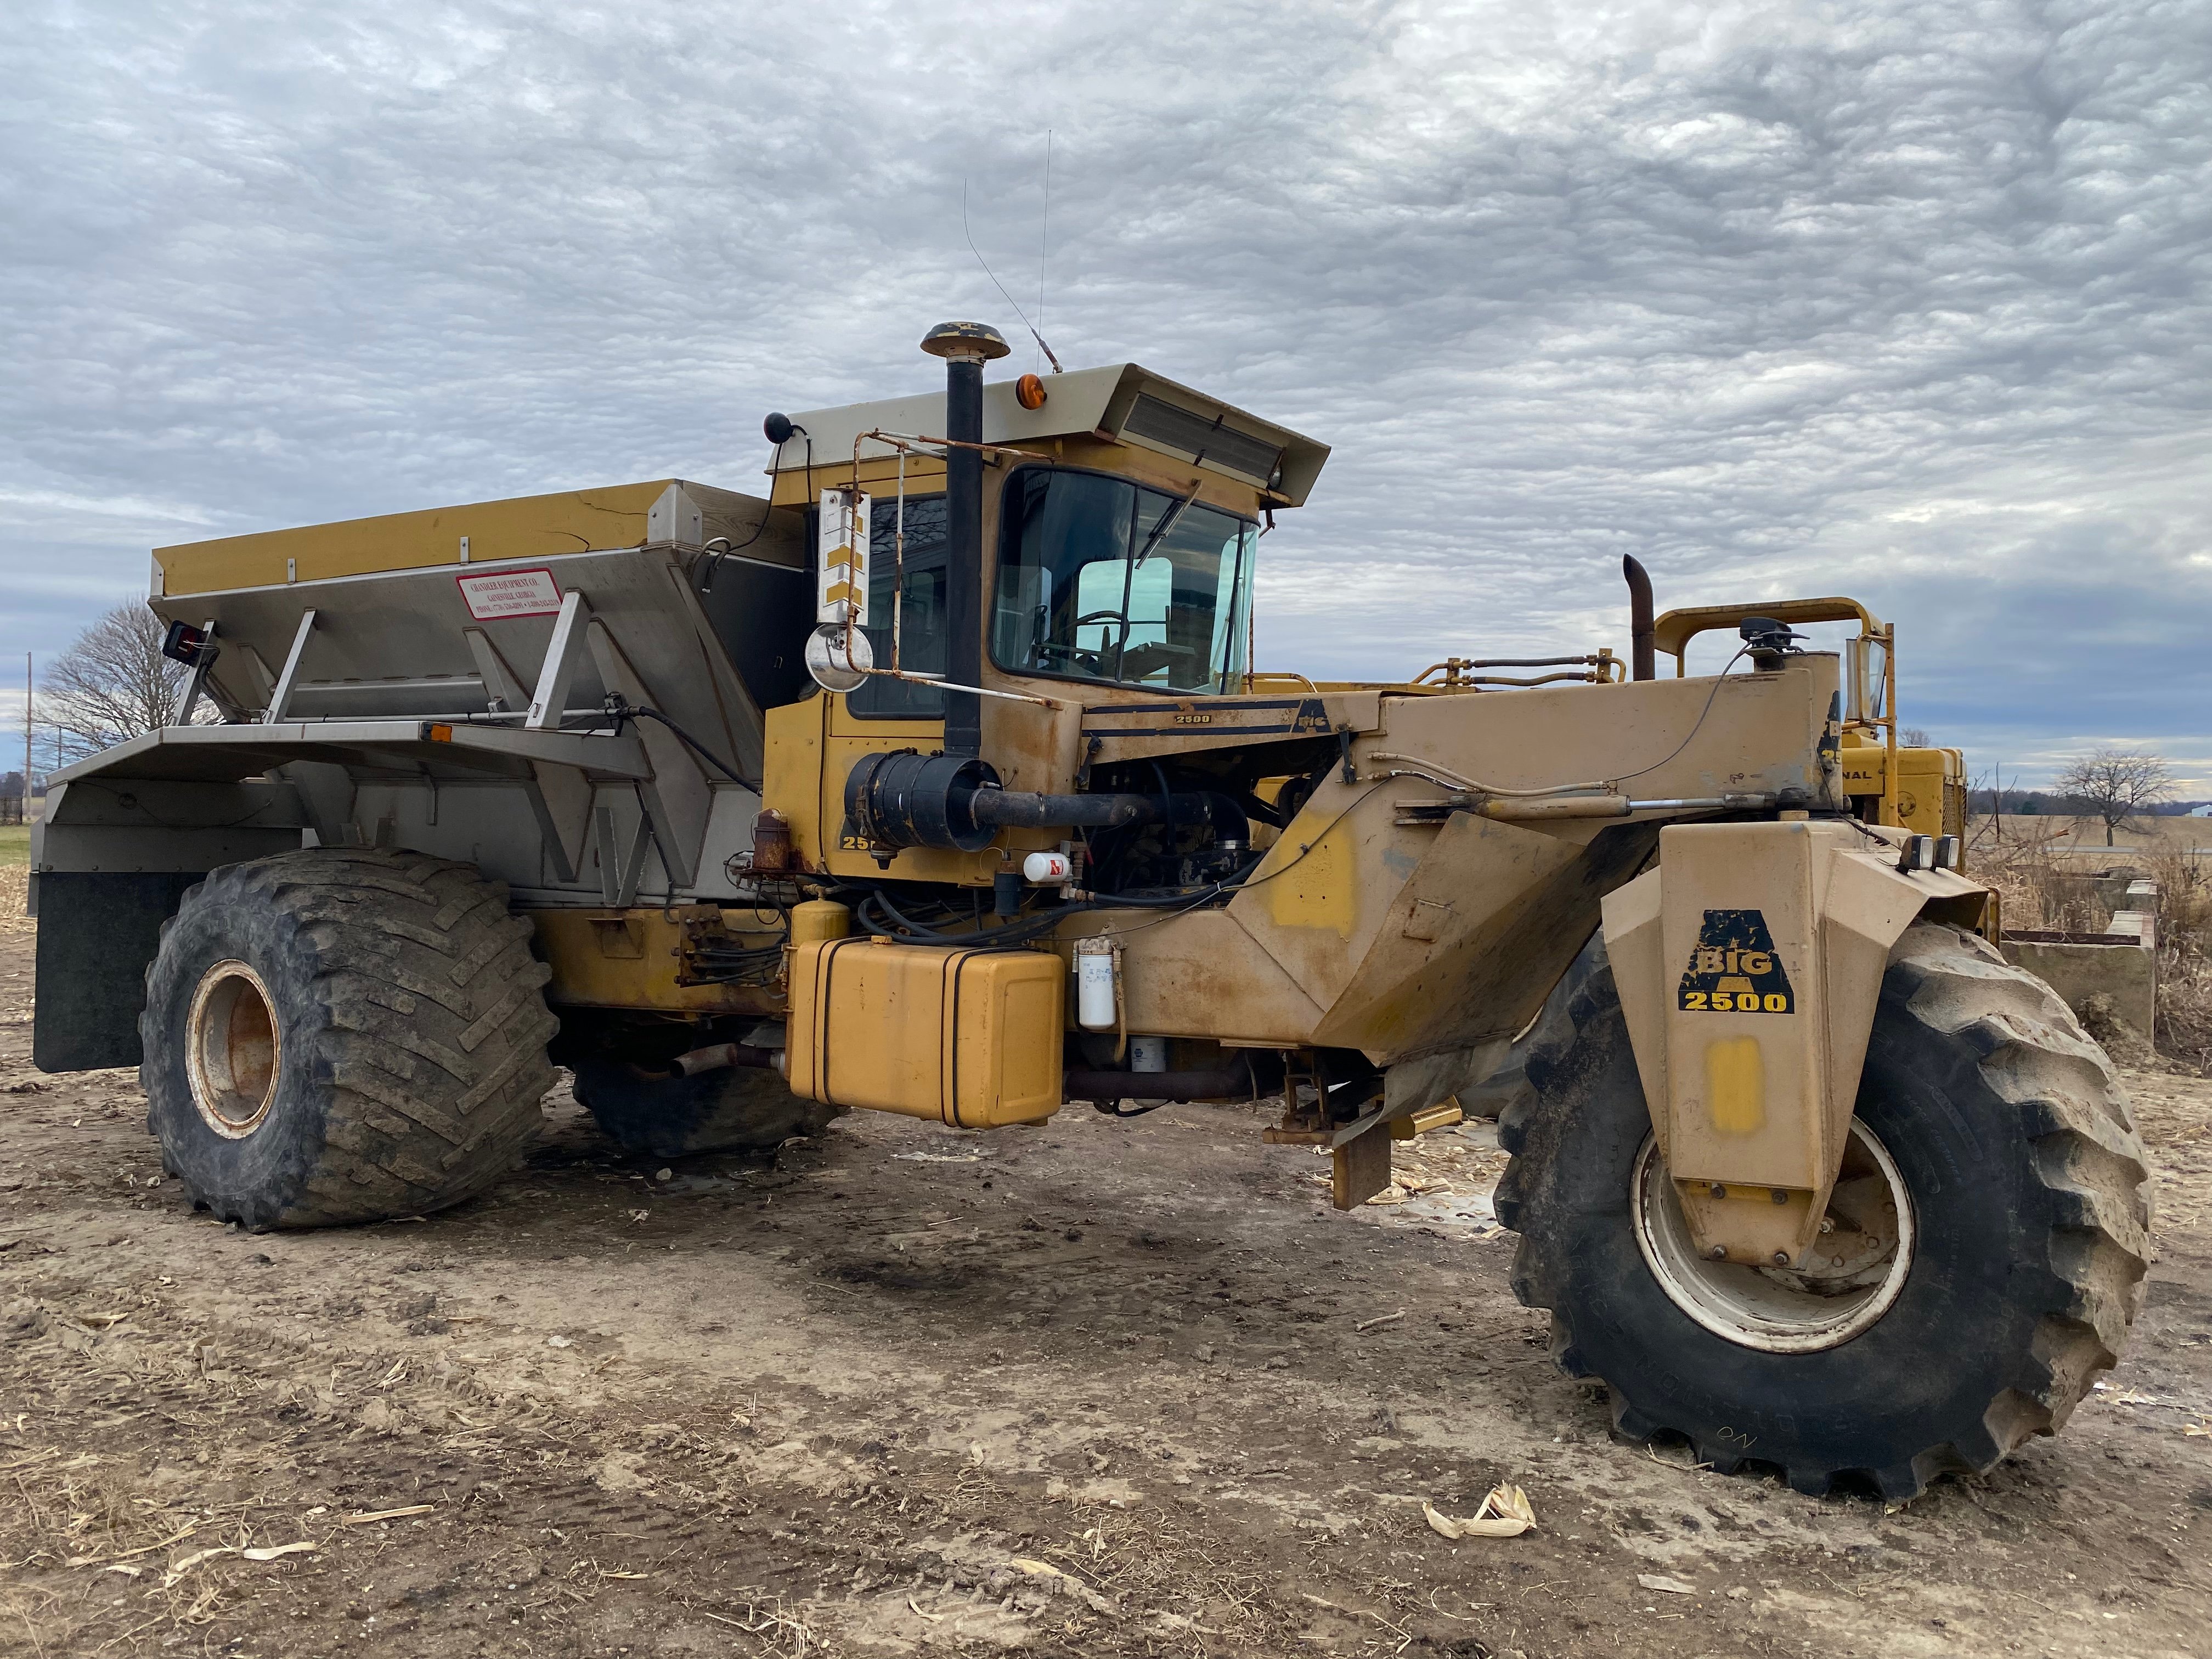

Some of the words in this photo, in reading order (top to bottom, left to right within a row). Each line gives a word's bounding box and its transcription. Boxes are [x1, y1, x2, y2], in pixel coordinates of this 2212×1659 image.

[470, 582, 499, 592] CHANDLER
[497, 579, 529, 591] EQUIPMENT
[515, 591, 537, 599] GEORGIA
[1697, 951, 1772, 975] BIG
[1685, 992, 1786, 1012] 2500
